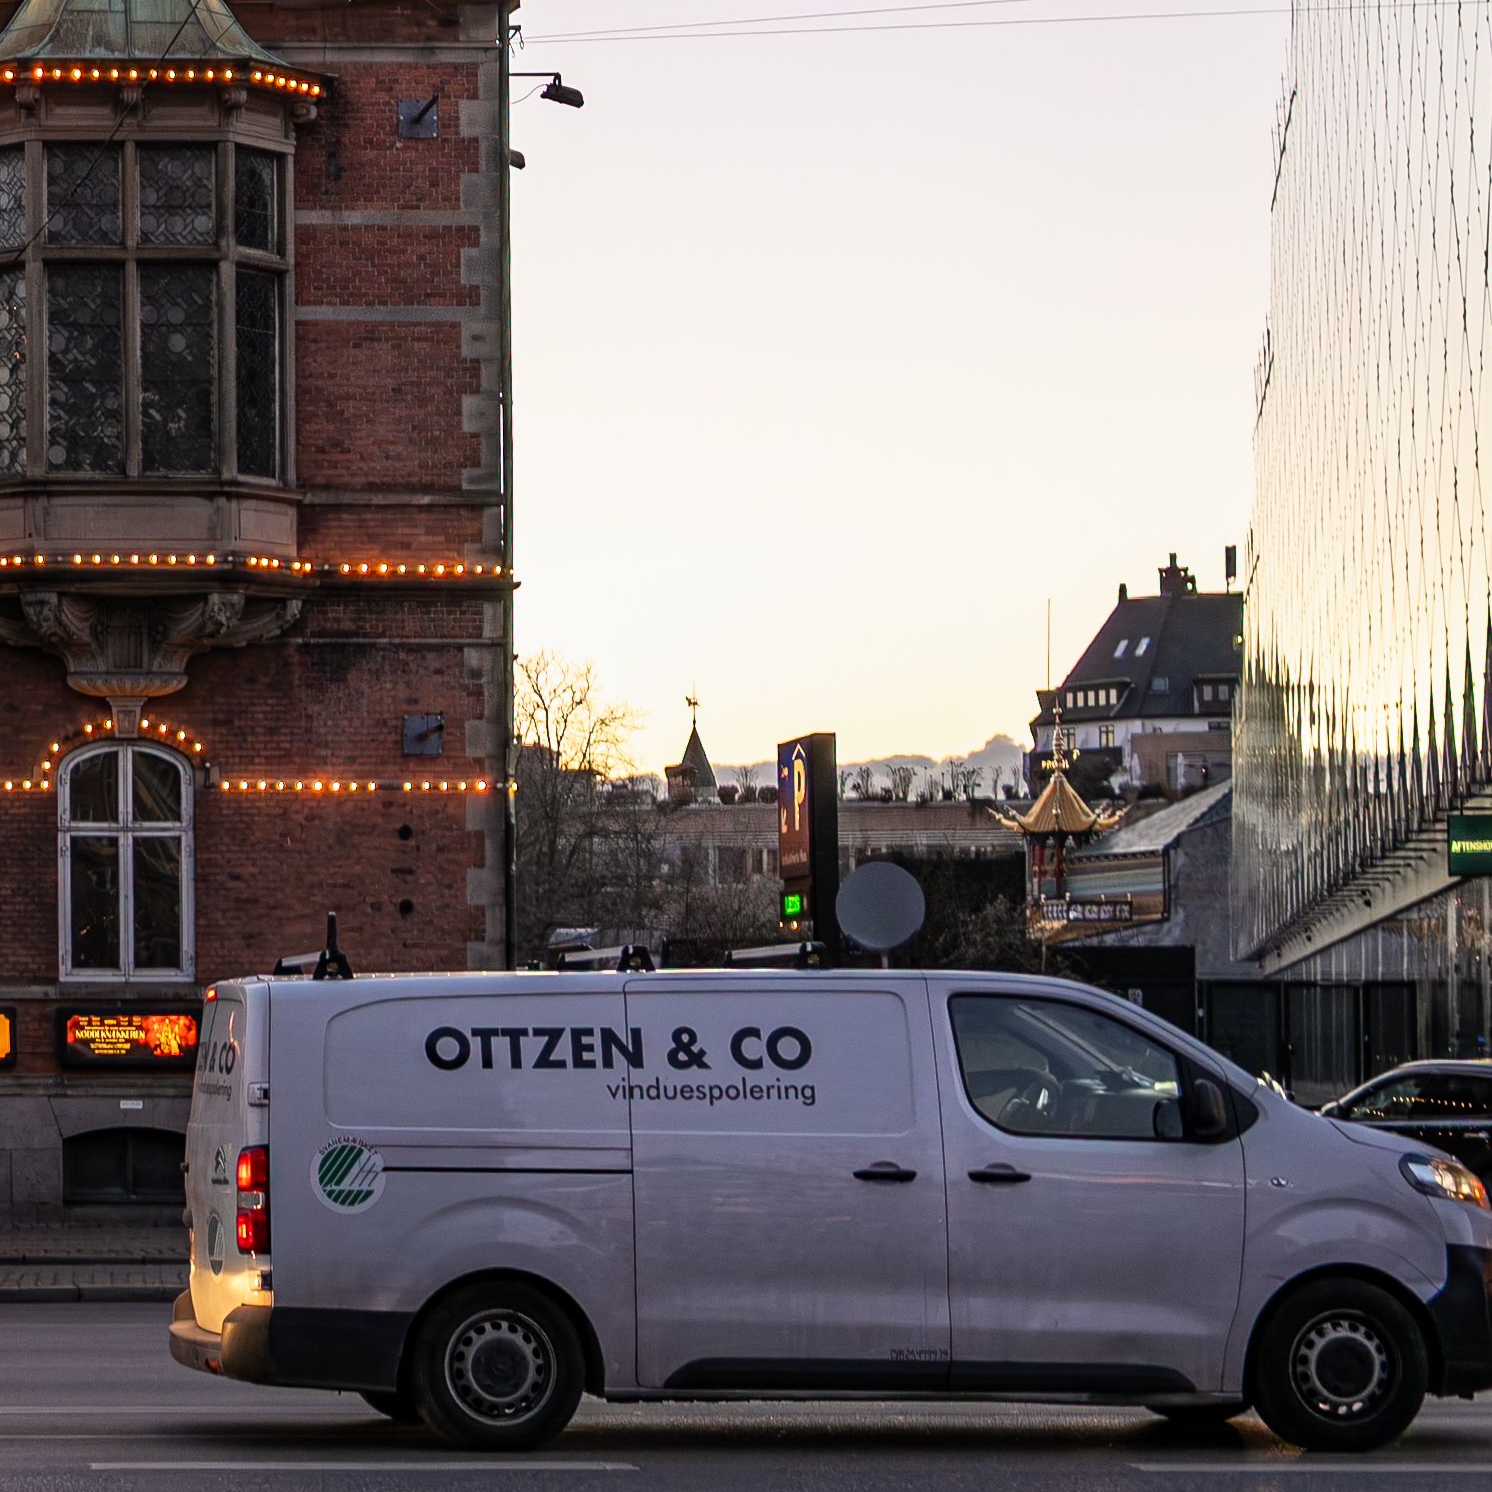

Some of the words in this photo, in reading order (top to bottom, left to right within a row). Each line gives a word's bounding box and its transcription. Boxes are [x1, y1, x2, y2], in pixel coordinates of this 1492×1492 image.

[1451, 840, 1492, 852] AFTENSHO
[218, 1040, 236, 1075] CO
[425, 1026, 645, 1070] OTTZEN
[666, 1026, 712, 1070] &
[730, 1026, 813, 1070] CO
[606, 1076, 817, 1106] vinduespolering
